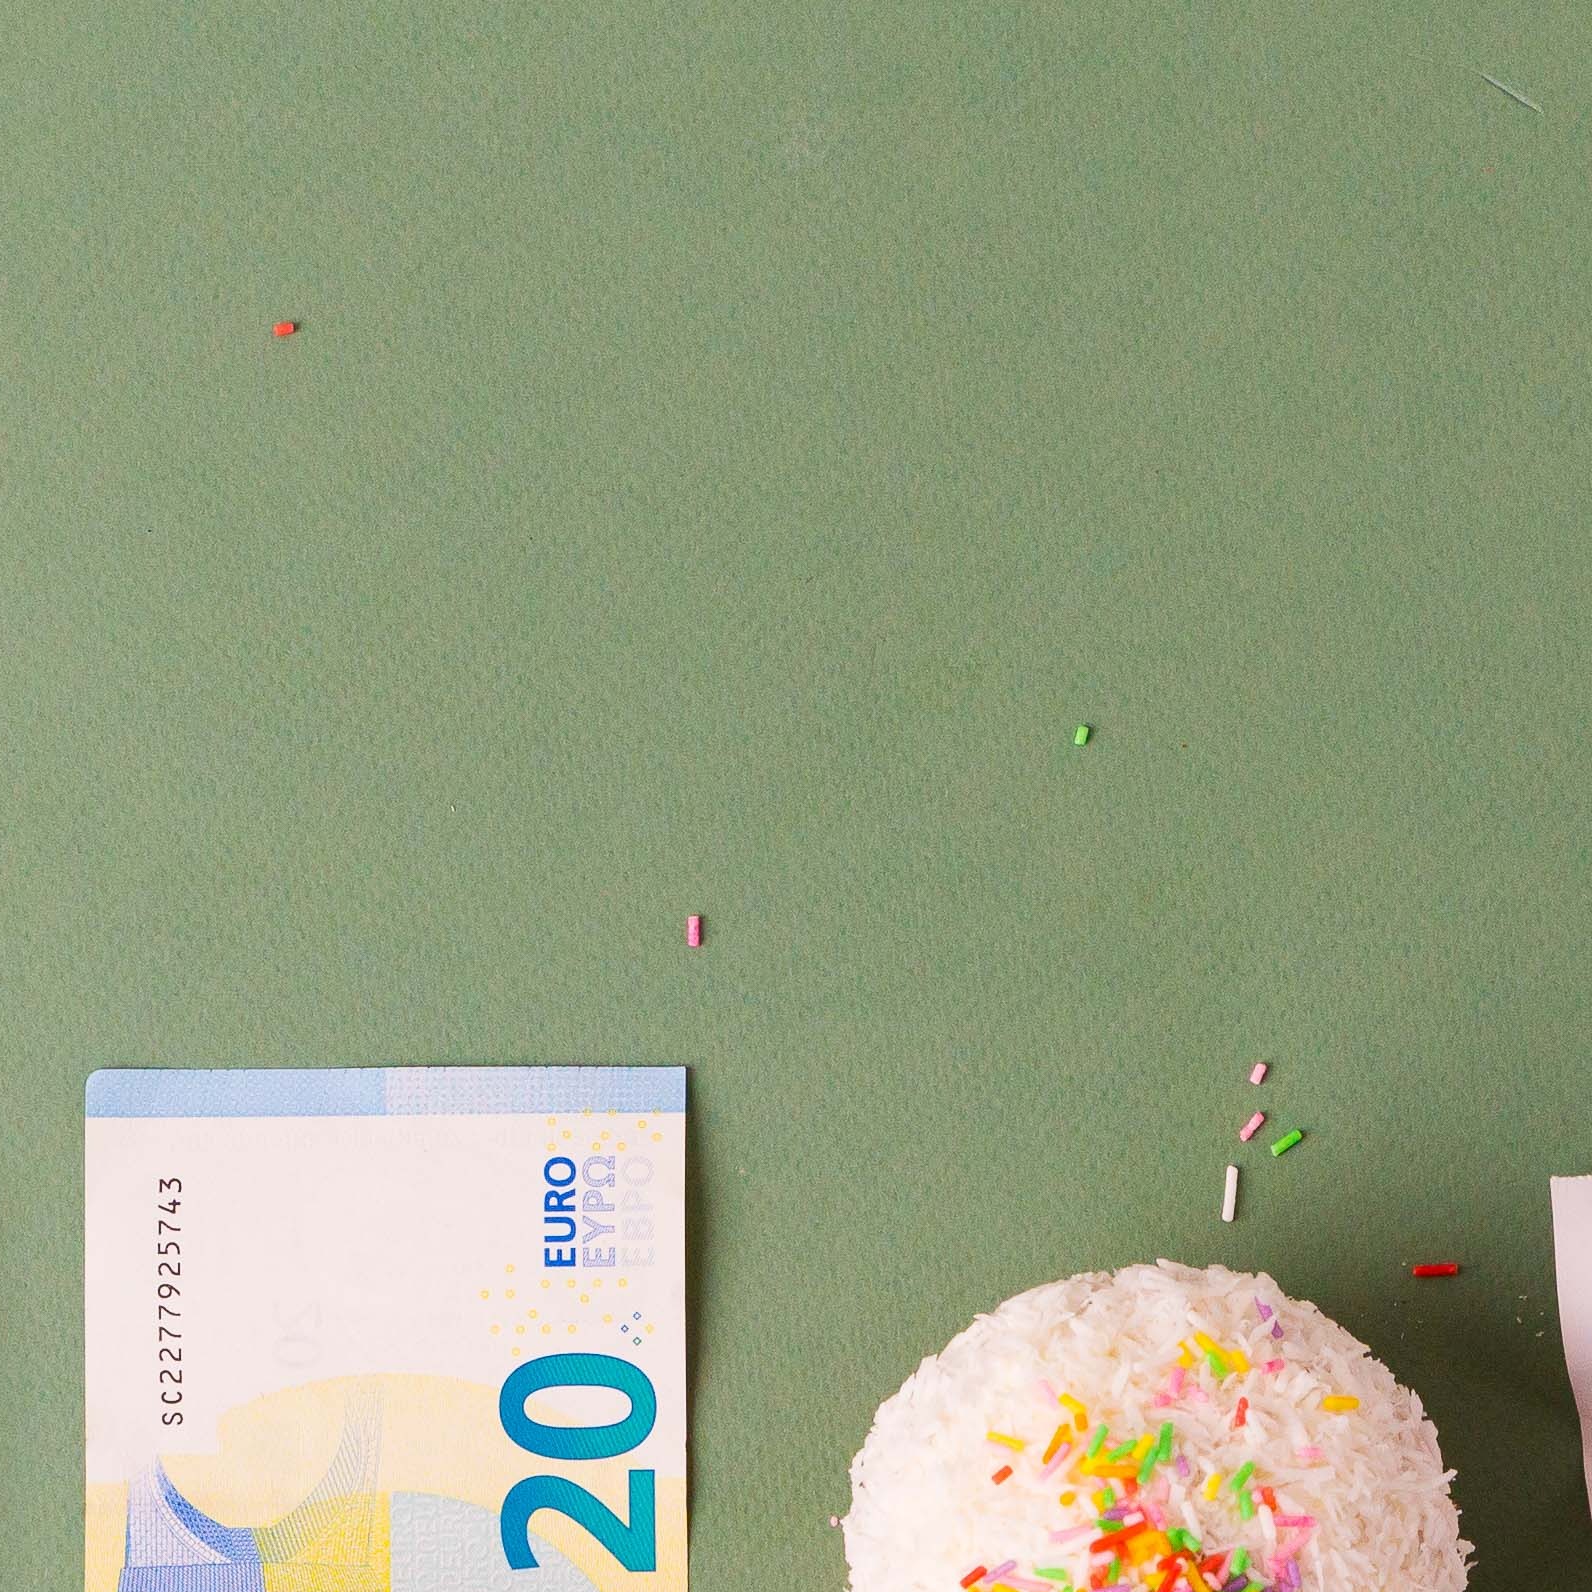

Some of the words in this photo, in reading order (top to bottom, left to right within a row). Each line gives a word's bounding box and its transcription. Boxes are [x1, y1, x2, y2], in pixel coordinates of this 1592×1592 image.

[156, 1176, 184, 1426] SC2277925743
[543, 1156, 577, 1267] EURO
[498, 1352, 657, 1573] 20
